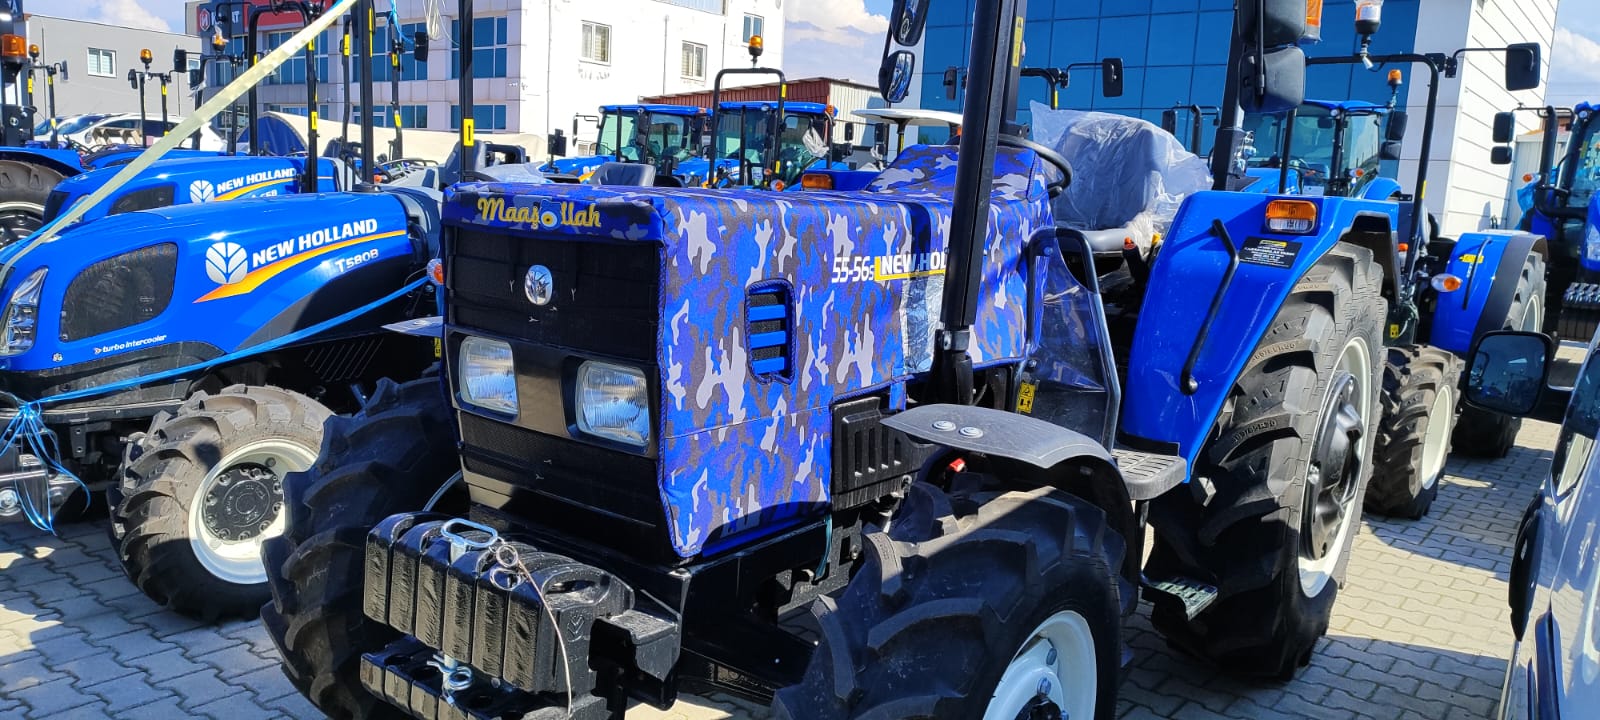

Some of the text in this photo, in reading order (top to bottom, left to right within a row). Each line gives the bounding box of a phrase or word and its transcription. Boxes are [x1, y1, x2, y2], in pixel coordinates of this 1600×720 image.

[216, 167, 297, 193] NEW HOLLAND
[252, 218, 378, 268] NEW HOLLAND
[335, 248, 379, 273] T580B
[881, 253, 916, 275] NEW
[919, 251, 947, 271] HOL
[102, 334, 167, 353] turbo intercooler
